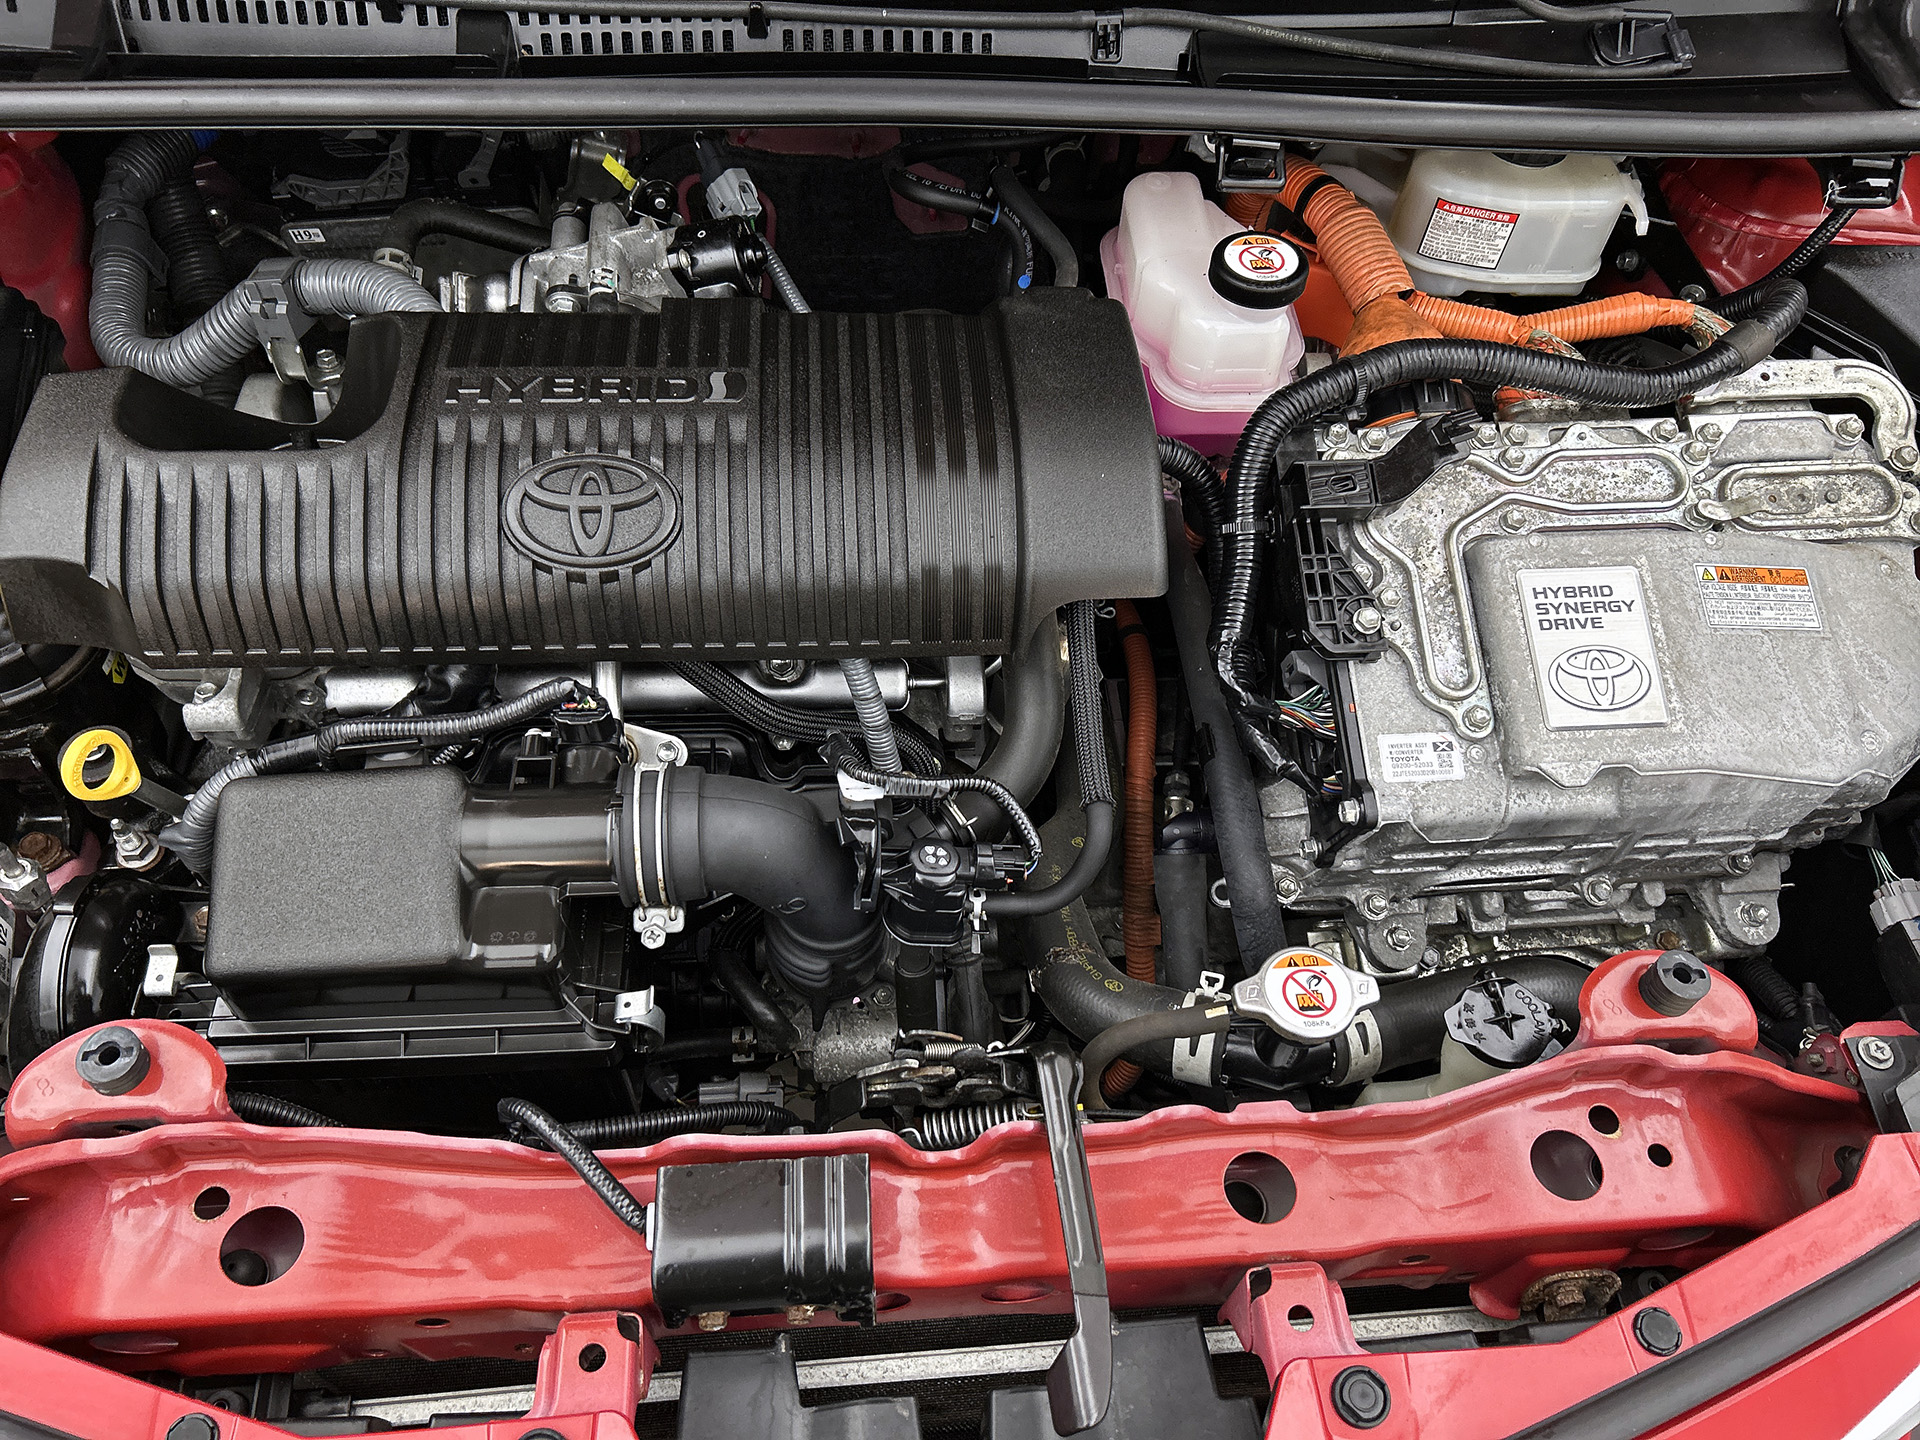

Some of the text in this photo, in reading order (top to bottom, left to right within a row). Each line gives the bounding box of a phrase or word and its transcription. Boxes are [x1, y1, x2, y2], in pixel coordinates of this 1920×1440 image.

[1463, 207, 1496, 219] DANGER
[291, 230, 313, 241] H9
[445, 376, 699, 403] HYBRID
[1532, 585, 1613, 599] HYBRID
[1535, 600, 1635, 615] SYNERGY
[1538, 617, 1604, 631] DRIVE
[1303, 1019, 1331, 1028] 108kPa
